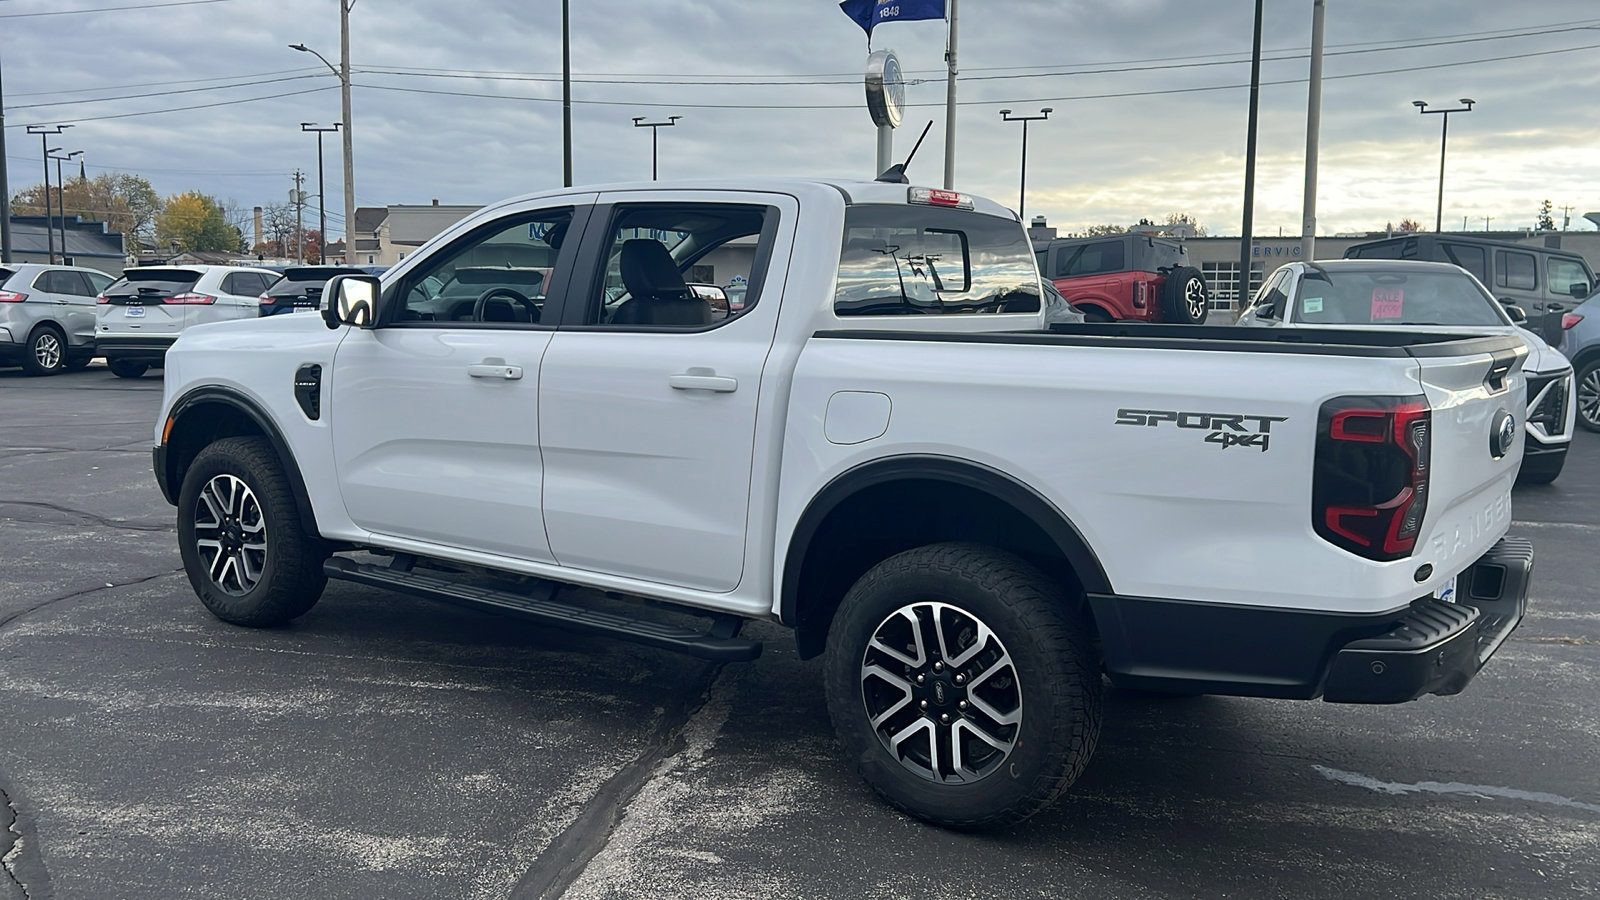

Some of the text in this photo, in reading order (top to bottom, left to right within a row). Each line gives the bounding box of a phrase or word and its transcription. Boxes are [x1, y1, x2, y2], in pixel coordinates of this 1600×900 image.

[880, 6, 899, 18] 1848
[1253, 246, 1301, 256] ERVIC
[1374, 292, 1400, 303] SALE
[1114, 408, 1289, 433] SPORT
[1204, 431, 1270, 452] 4x4
